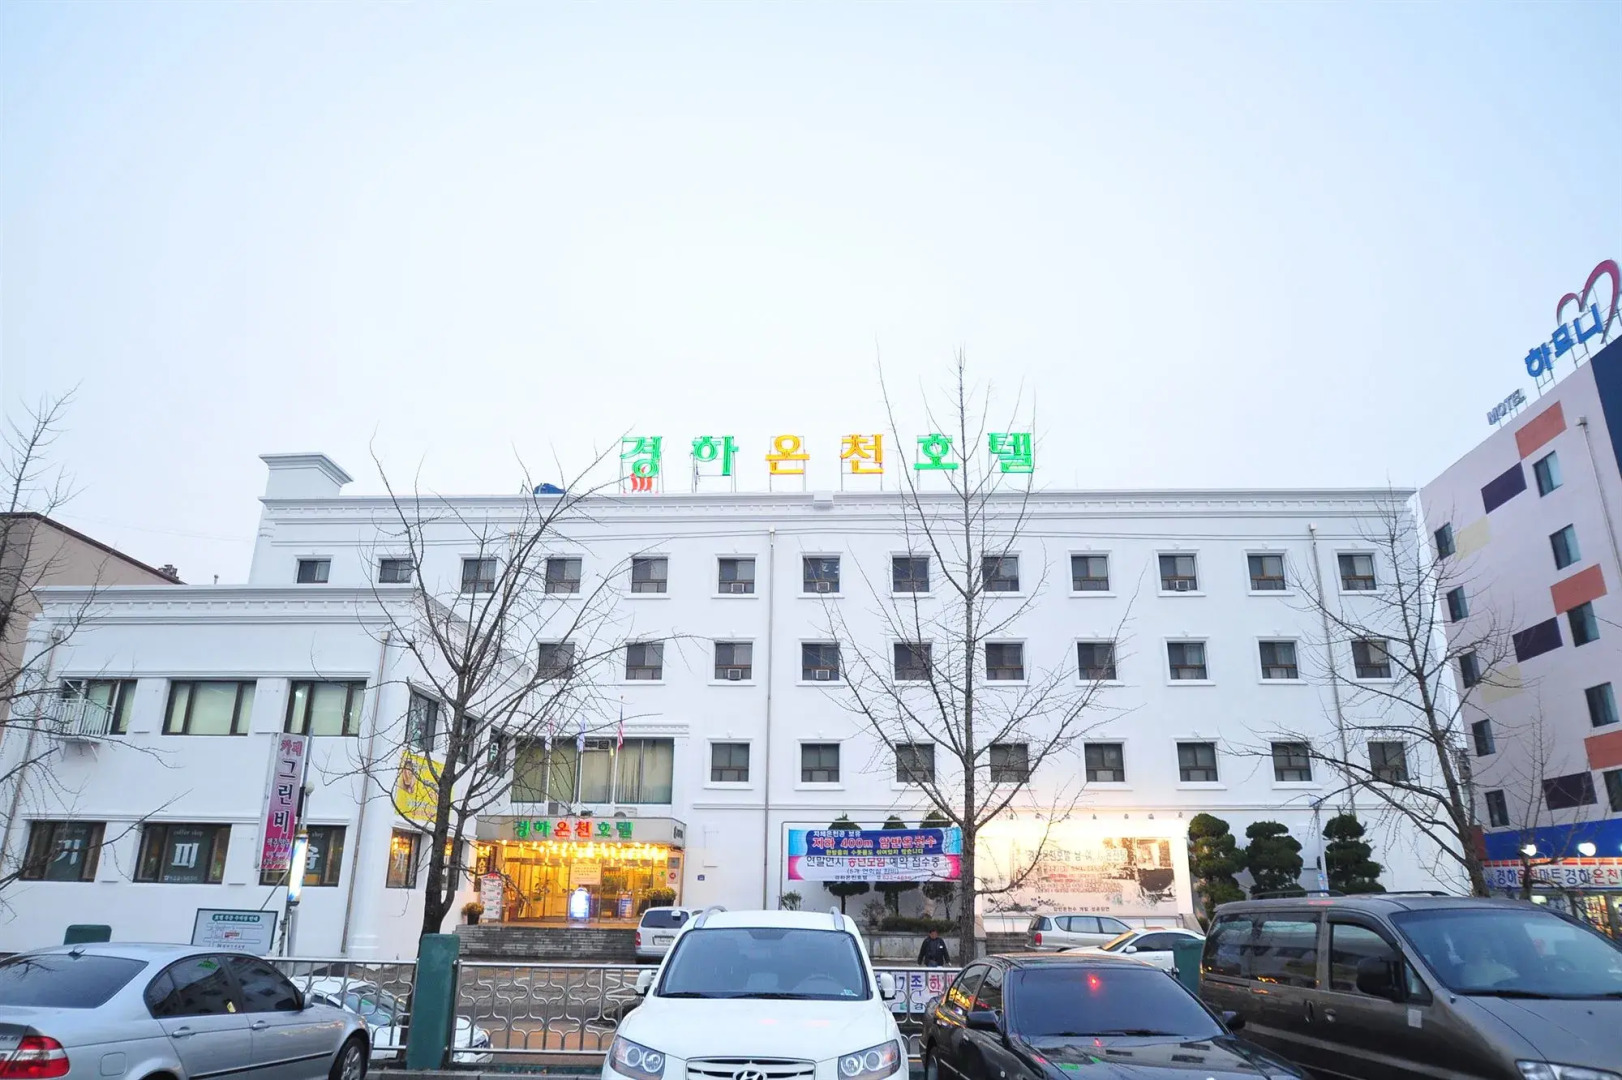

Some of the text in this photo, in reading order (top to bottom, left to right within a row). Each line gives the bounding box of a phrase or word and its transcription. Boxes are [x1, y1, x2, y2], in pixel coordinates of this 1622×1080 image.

[1525, 302, 1604, 378] 하모니
[1487, 389, 1527, 425] MOTEL
[620, 433, 1035, 478] 경하온천호텔
[280, 738, 303, 757] 카페
[273, 760, 297, 833] 그린비
[512, 820, 634, 840] 경하온천호텔
[840, 837, 874, 850] 400m
[806, 856, 940, 868] 연말연시 송년모임 예약 접수중
